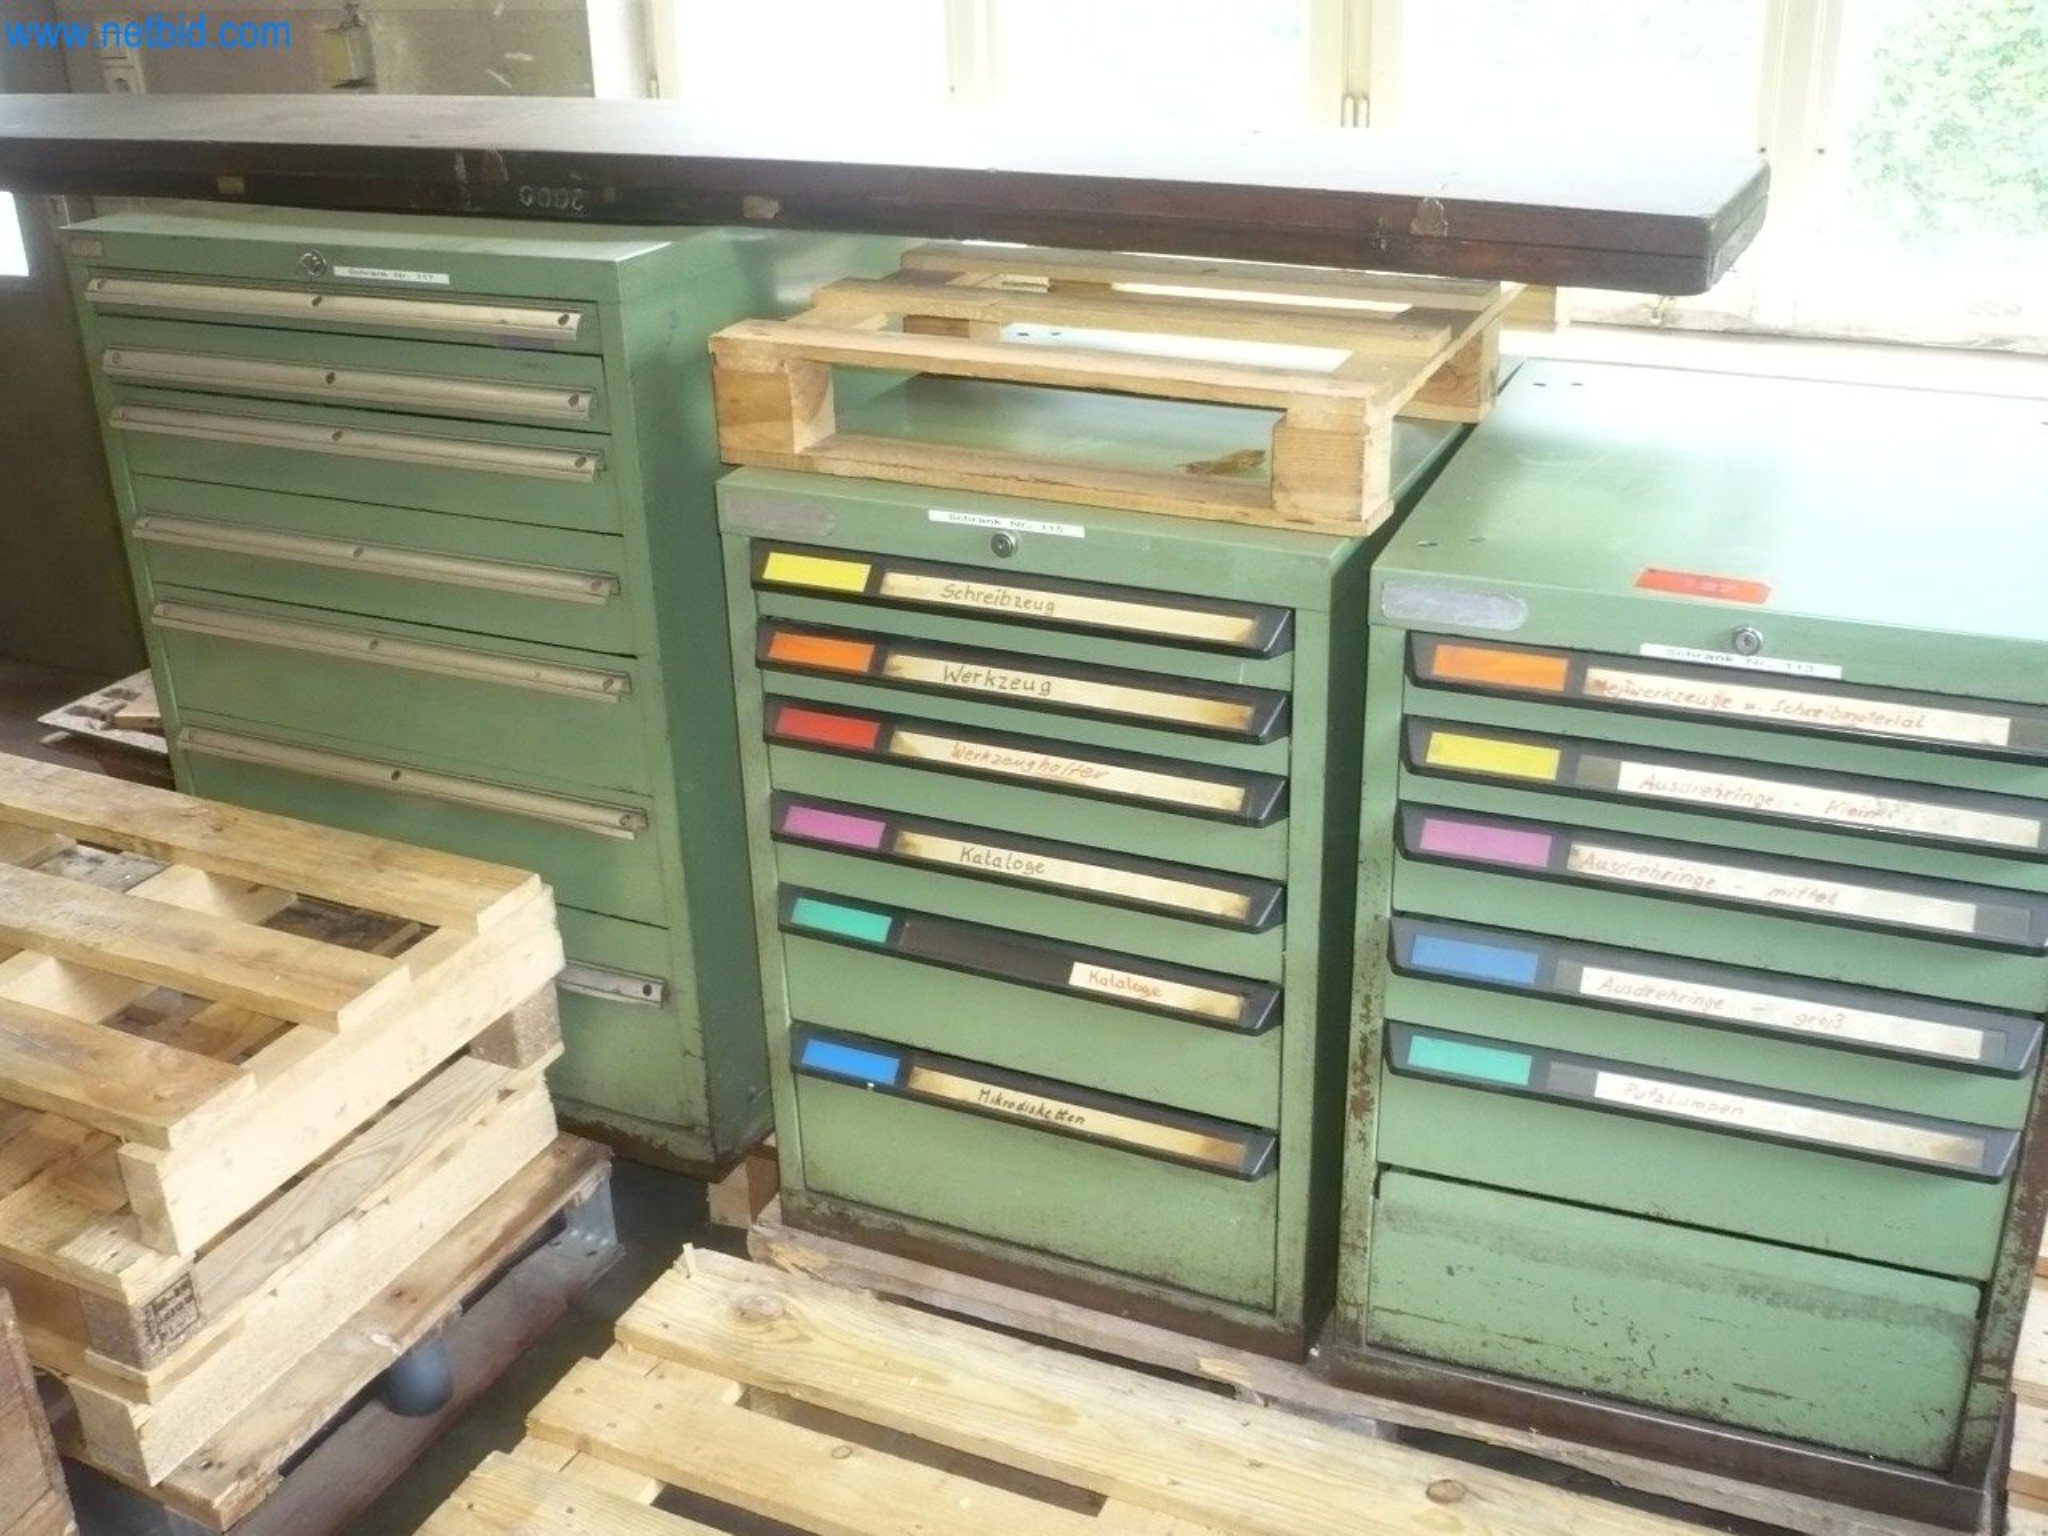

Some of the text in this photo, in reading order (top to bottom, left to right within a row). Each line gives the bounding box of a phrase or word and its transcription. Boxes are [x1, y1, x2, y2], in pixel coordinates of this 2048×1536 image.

[938, 582, 1057, 617] Schreibzeug
[941, 664, 1052, 697] Werkzeug
[1637, 775, 1776, 809] Ausdrehringe
[958, 845, 1047, 877] Kataloge
[1581, 852, 1717, 891] Ausdrehringe
[1087, 969, 1163, 998] Kataloge
[1597, 976, 1725, 1012] Ausdrehringe
[977, 1087, 1087, 1126] Mikrodisketten
[1623, 1081, 1746, 1117] Putzlumpen
